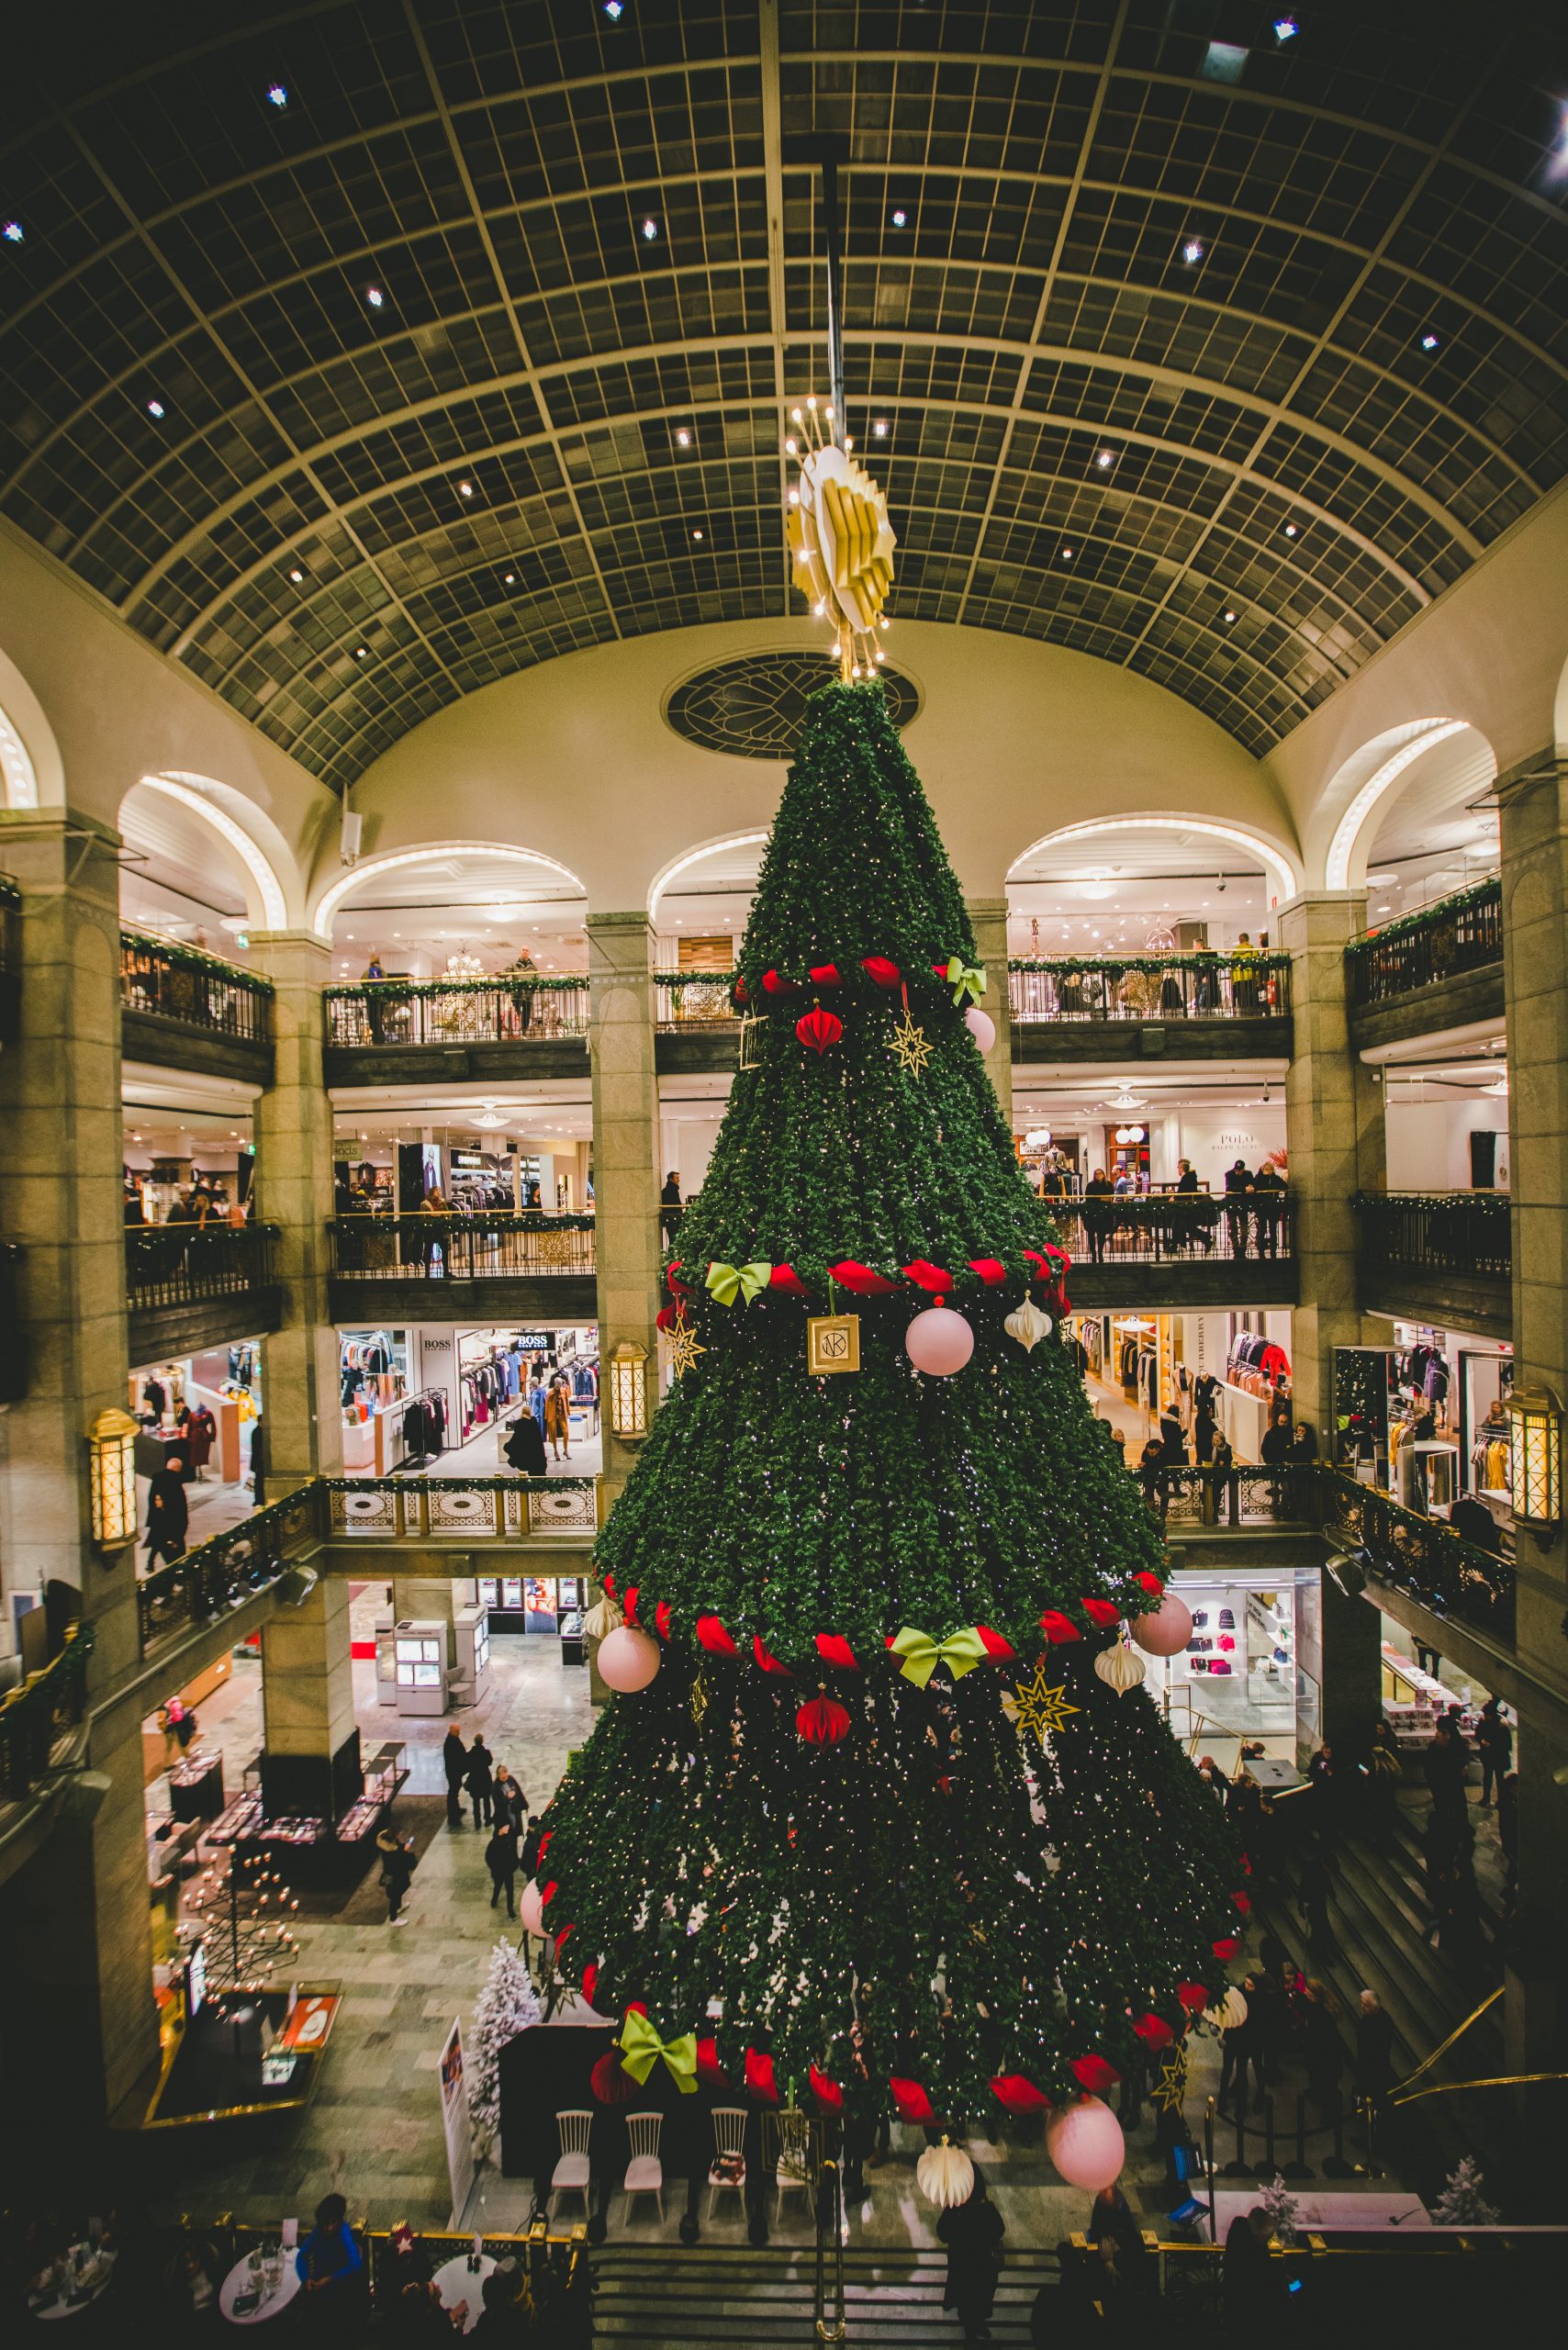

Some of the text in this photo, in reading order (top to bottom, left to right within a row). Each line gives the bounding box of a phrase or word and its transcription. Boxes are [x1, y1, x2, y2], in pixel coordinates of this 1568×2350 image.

[1221, 1135, 1254, 1144] POLO
[518, 1336, 548, 1345] BOSS
[823, 1333, 846, 1357] NK
